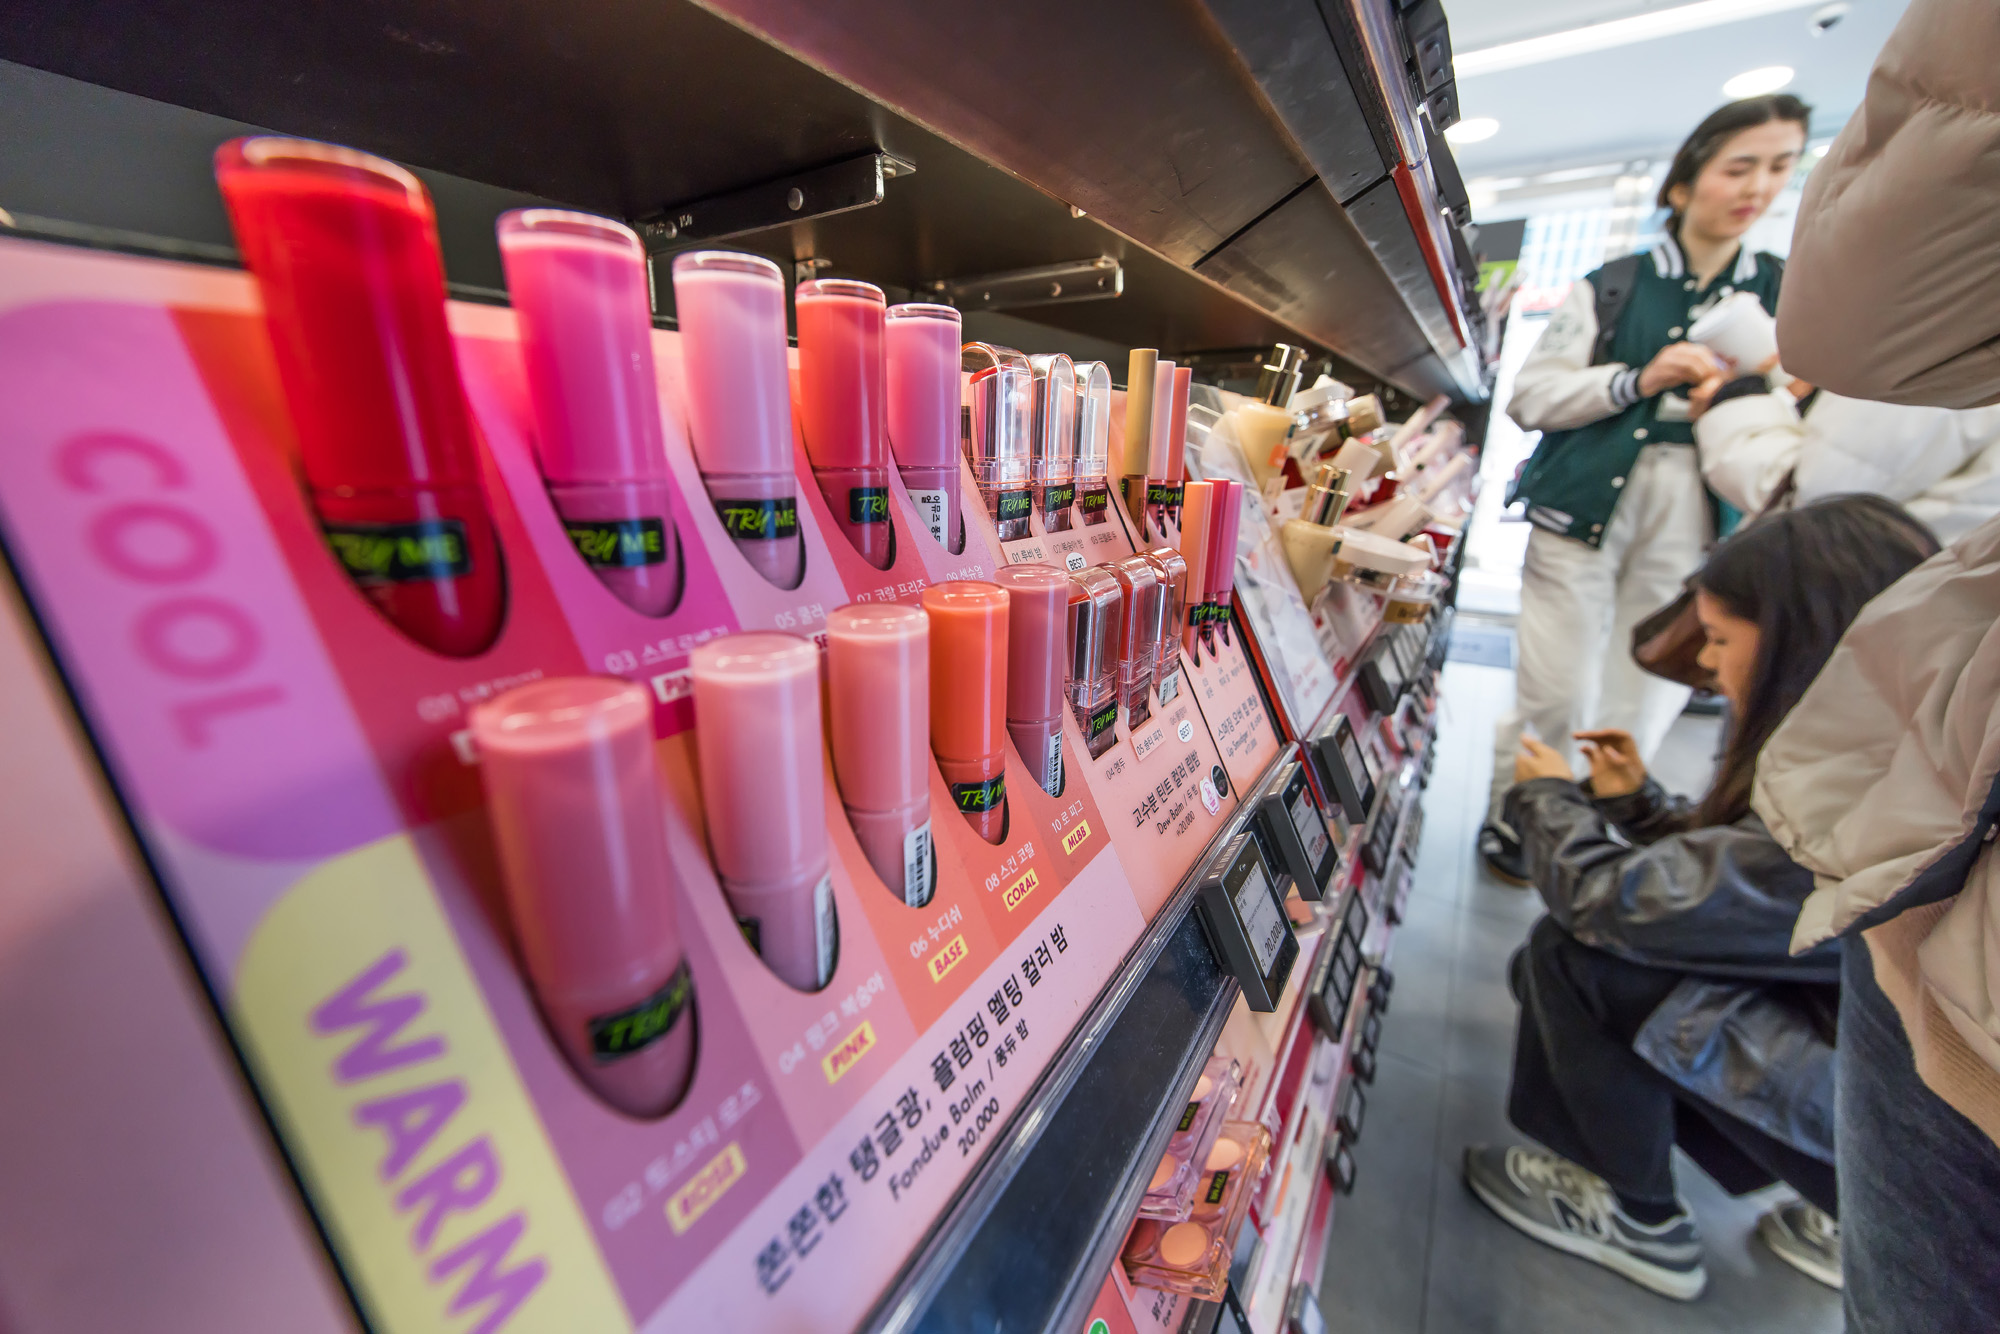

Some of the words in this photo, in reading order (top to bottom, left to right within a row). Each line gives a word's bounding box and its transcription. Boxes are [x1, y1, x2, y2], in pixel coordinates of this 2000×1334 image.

[858, 495, 889, 514] TRY
[1002, 499, 1018, 514] TRY
[1018, 497, 1030, 509] ME
[1049, 489, 1063, 504] TRY
[1063, 489, 1073, 501] ME
[1085, 495, 1097, 508] TRY
[1097, 494, 1106, 505] ME
[723, 507, 772, 535] TRY
[774, 508, 796, 528] ME
[620, 531, 661, 554] ME
[1012, 552, 1021, 563] 01
[1021, 549, 1035, 562] 루비
[1034, 547, 1042, 559] 밤
[1053, 544, 1062, 554] 02
[1068, 557, 1084, 571] BEST
[53, 428, 286, 753] COOL
[874, 586, 898, 602] 코랄
[897, 579, 927, 597] 프리즈
[775, 611, 796, 629] 05
[604, 650, 639, 675] 03
[1093, 714, 1106, 733] TRY
[1105, 708, 1116, 724] ME
[1179, 723, 1193, 740] BEST
[1136, 744, 1145, 756] 05
[1105, 767, 1115, 781] 04
[960, 786, 996, 806] TRY
[1132, 792, 1160, 828] 고수분
[1156, 777, 1174, 804] 틴트
[1171, 762, 1188, 788] 컬러
[1185, 749, 1201, 774] 립밤
[1051, 818, 1062, 833] 10
[1061, 811, 1071, 826] 로
[1068, 799, 1084, 817] 피그
[1156, 817, 1171, 835] Dew
[1169, 802, 1185, 820] Balm
[1067, 825, 1087, 850] MLBB
[985, 873, 1000, 892] 08
[1000, 855, 1019, 880] 스킨
[1017, 841, 1036, 864] 코랄
[1006, 873, 1037, 907] CORAL
[910, 936, 929, 959] 06
[927, 904, 963, 942] 누디쉬
[934, 940, 964, 975] BASE
[779, 1043, 806, 1075] 04
[829, 1028, 871, 1075] PINK
[755, 1172, 849, 1296] 쫀쫀한
[849, 1086, 933, 1184] 탱글광,
[930, 1012, 991, 1093] 플럼핑
[987, 974, 1024, 1026] 멜팅
[1021, 939, 1054, 988] 컬러
[1050, 923, 1069, 953] 밤
[888, 1124, 949, 1202] Fondue
[949, 1078, 987, 1127] Balm
[994, 1033, 1018, 1069] 퐁듀
[1014, 1017, 1030, 1041] 밤
[307, 945, 552, 1334] WARM
[957, 1097, 1000, 1157] 20,000
